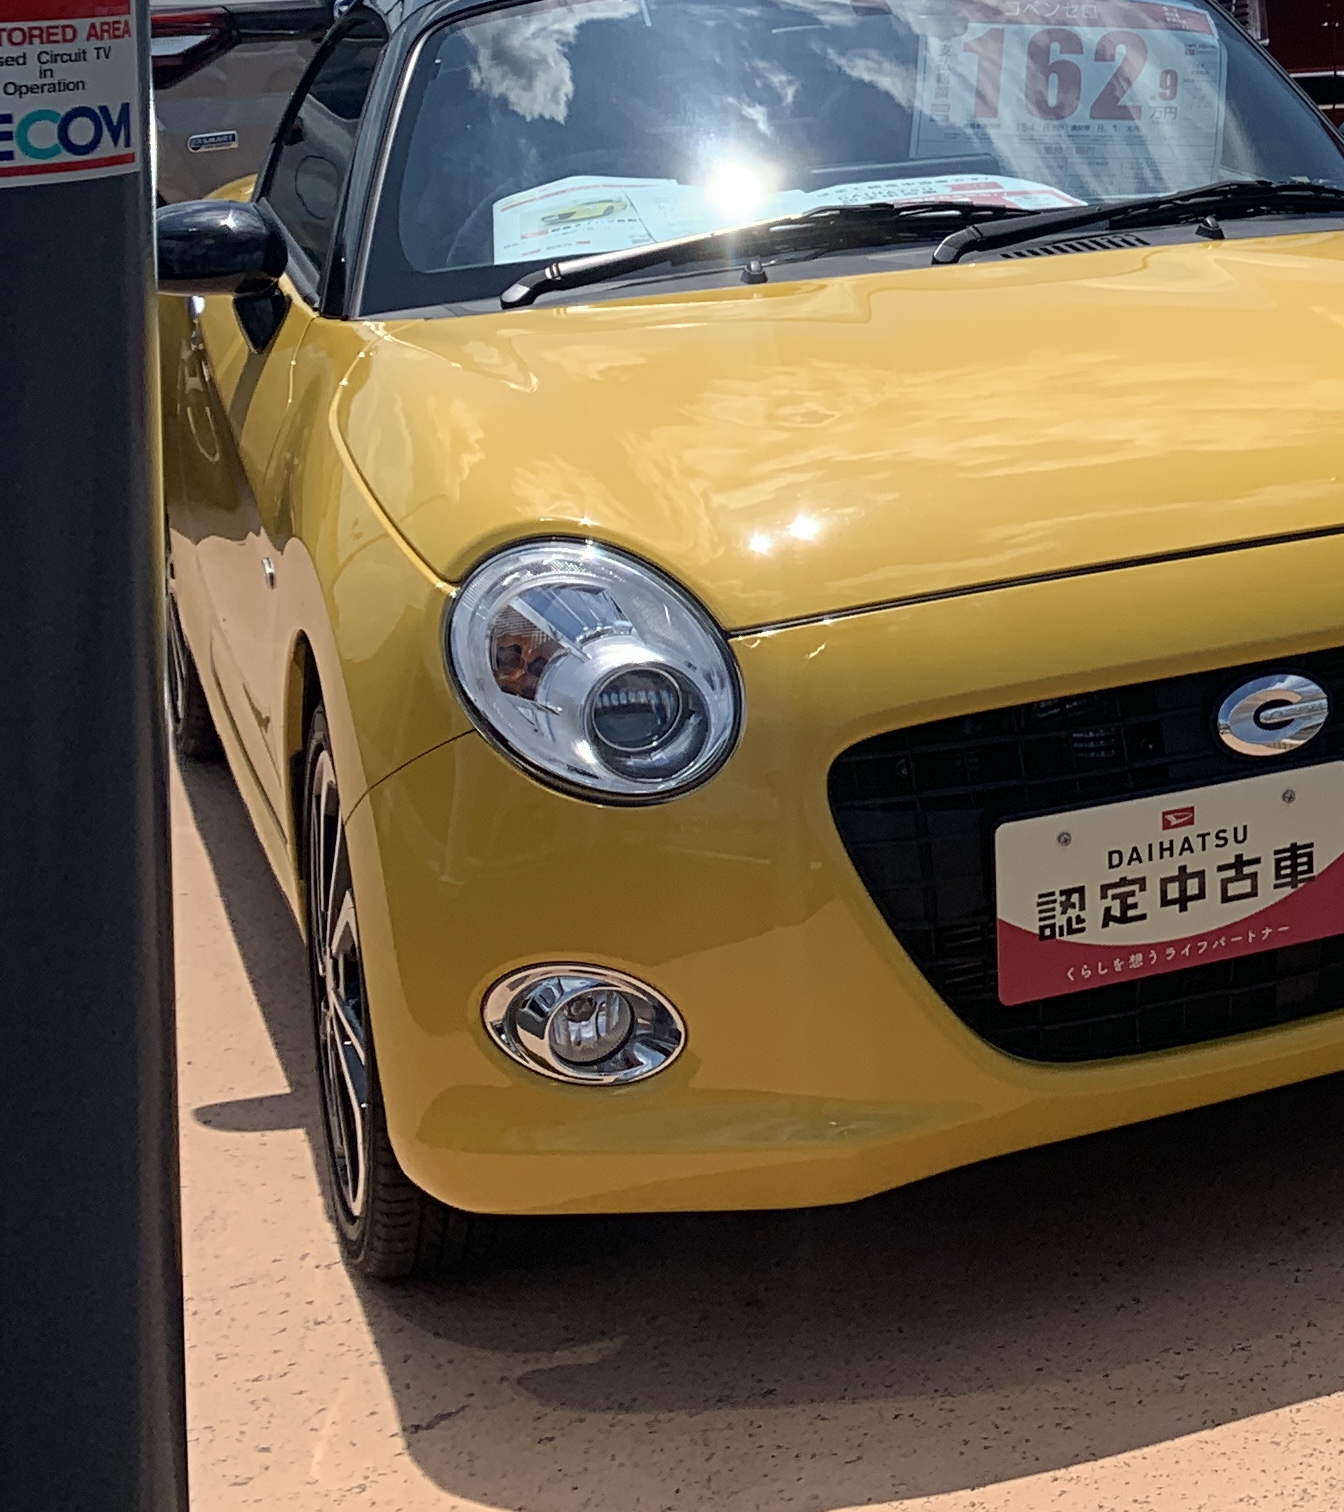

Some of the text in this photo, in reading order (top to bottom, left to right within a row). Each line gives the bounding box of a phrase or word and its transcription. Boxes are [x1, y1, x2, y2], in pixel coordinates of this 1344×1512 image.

[1004, 0, 1098, 20] コペンセロ
[85, 19, 131, 42] AREA
[37, 48, 87, 65] Circuit
[94, 45, 112, 60] TV
[39, 66, 54, 79] in
[963, 27, 1148, 120] 162
[3, 79, 86, 99] Operation
[1107, 824, 1248, 869] DAIHATSU
[1036, 841, 1317, 942] 認定中古車
[1065, 925, 1290, 982] くらしを想うライフパートナー
